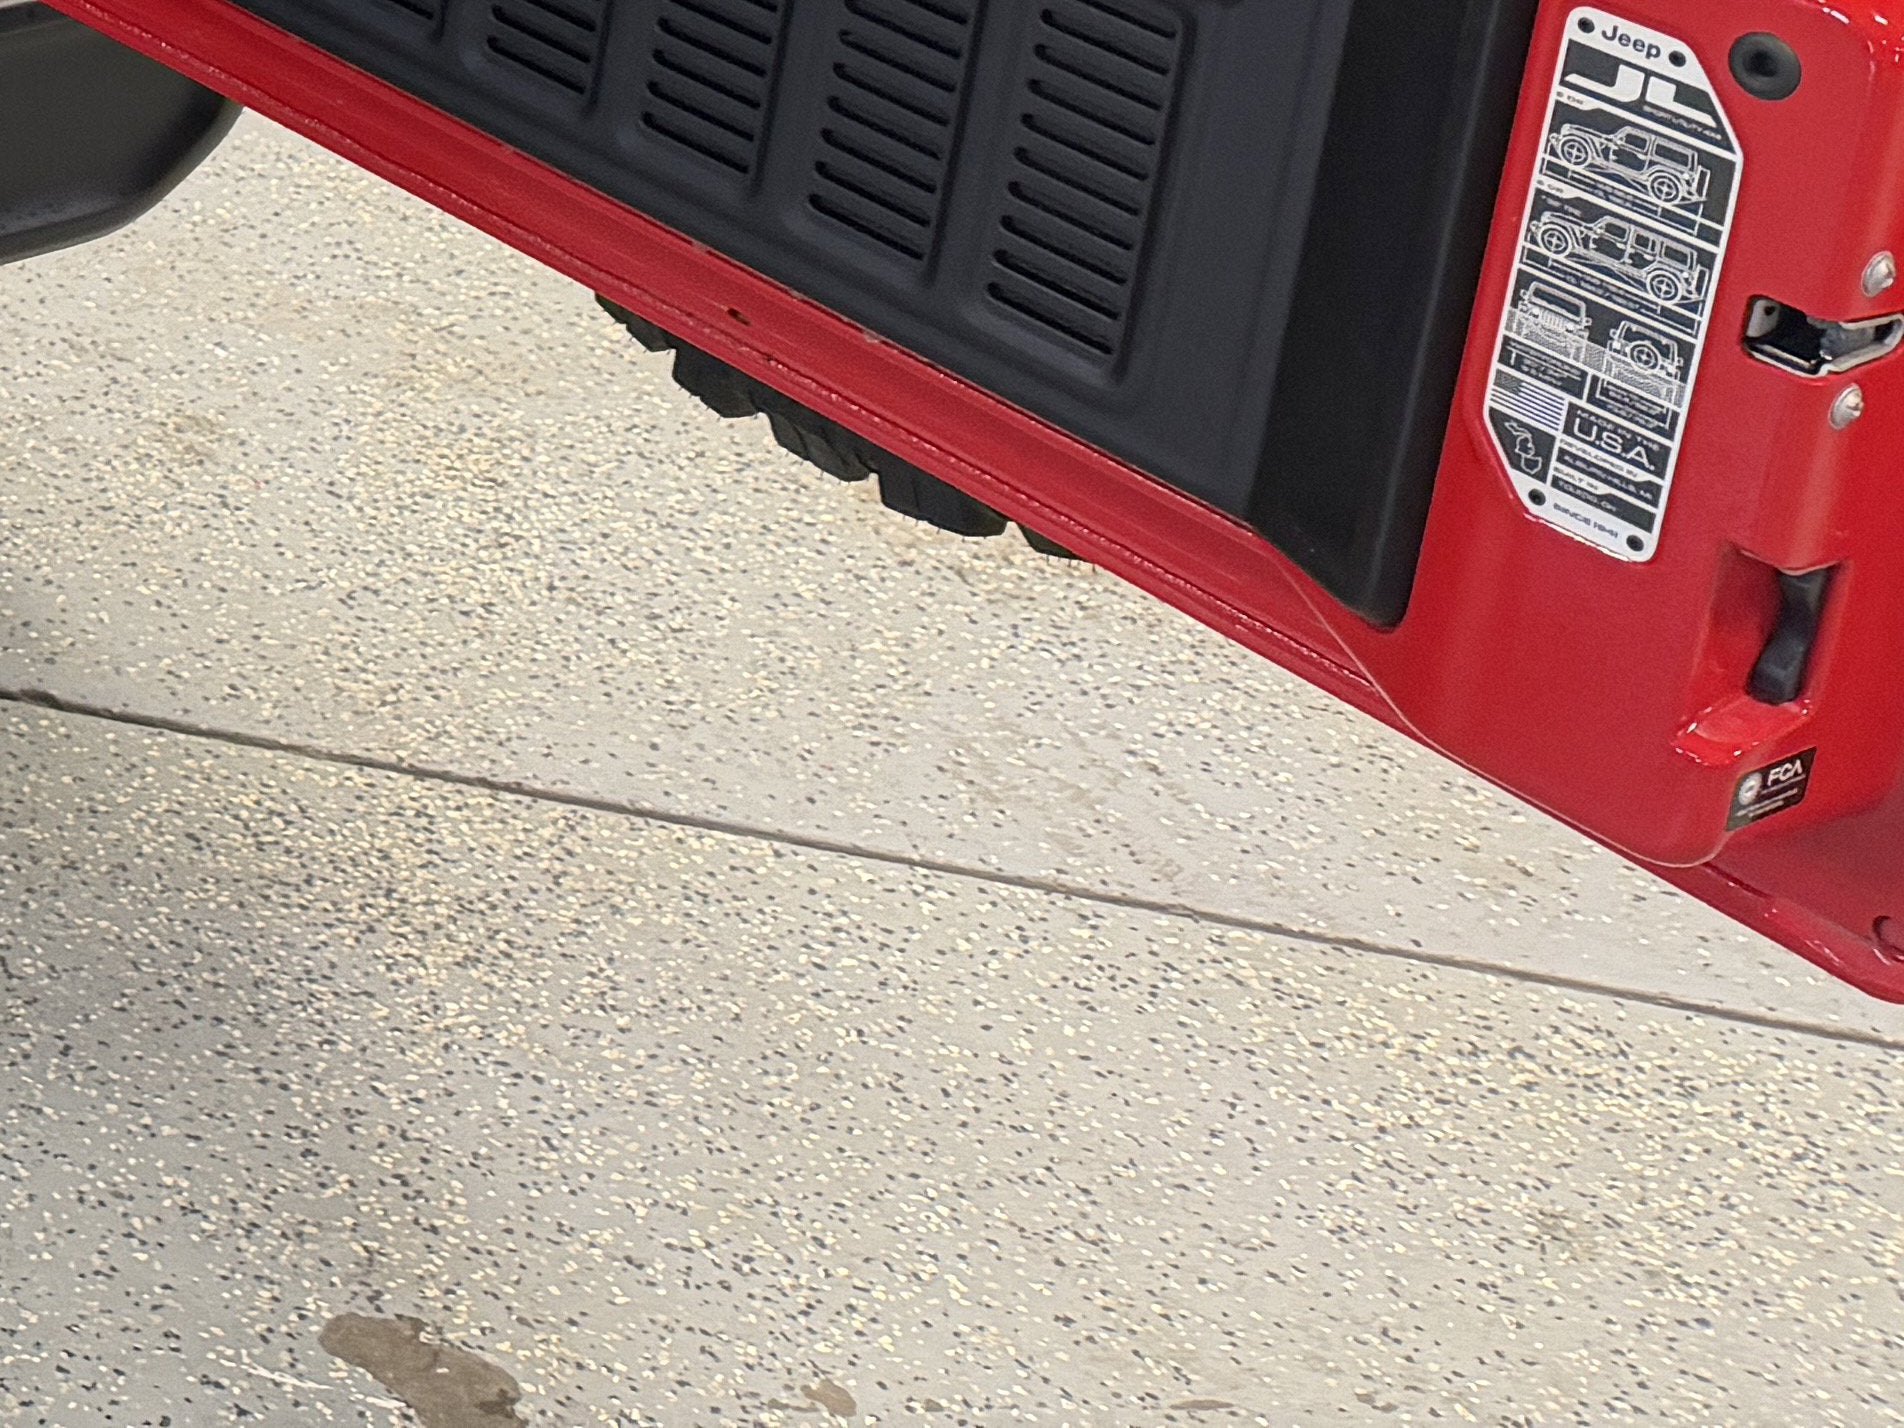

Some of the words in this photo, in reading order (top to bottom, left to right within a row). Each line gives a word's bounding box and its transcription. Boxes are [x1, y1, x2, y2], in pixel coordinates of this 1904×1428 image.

[1601, 25, 1662, 60] Jeep
[1564, 64, 1718, 129] JL
[1574, 417, 1655, 471] U.S.A.
